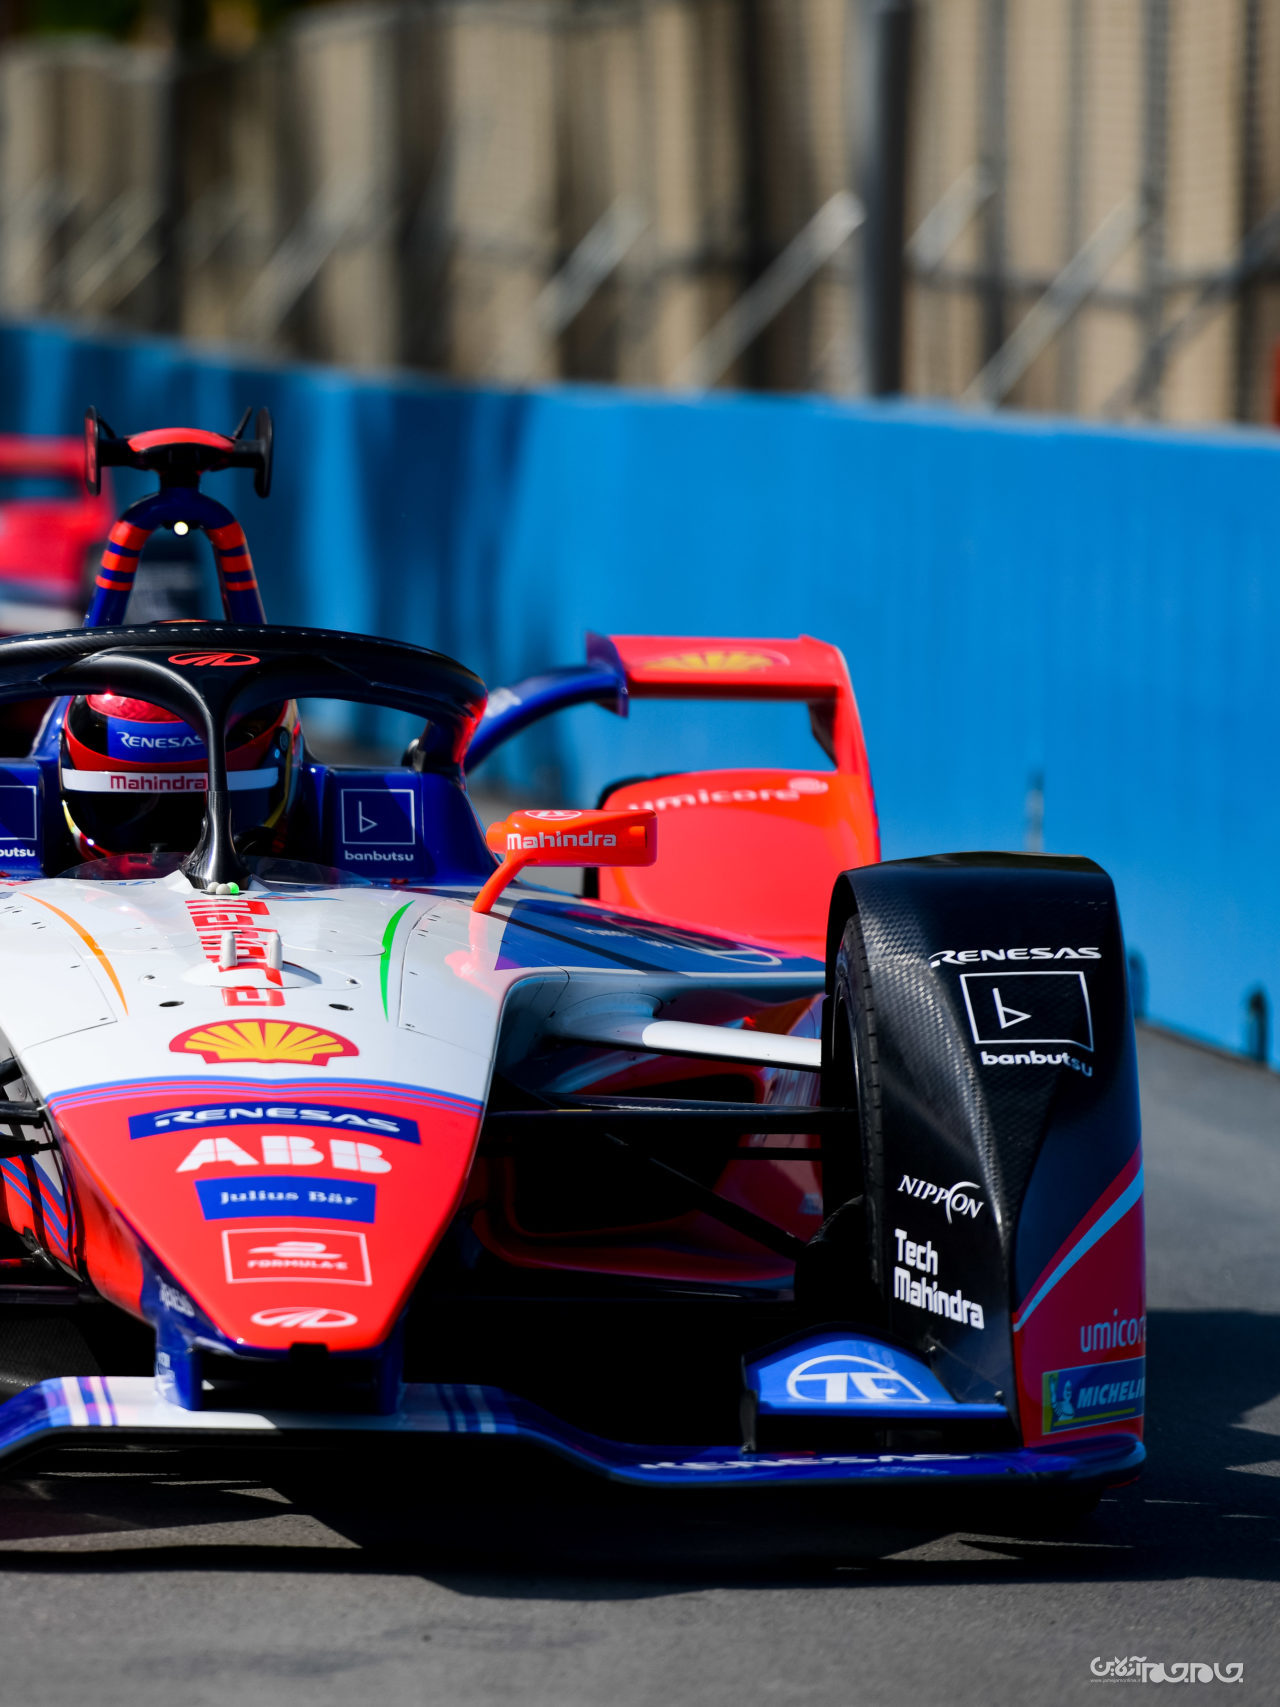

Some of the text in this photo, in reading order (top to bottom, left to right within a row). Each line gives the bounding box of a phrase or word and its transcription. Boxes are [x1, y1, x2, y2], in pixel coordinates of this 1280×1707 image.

[110, 775, 207, 791] Mahindra
[628, 789, 800, 811] umicore
[507, 831, 617, 850] Mahindra
[344, 850, 414, 862] banbutsu
[928, 947, 1102, 968] RENESAS
[980, 1051, 1093, 1077] banbutsu
[154, 1107, 401, 1132] RENESAS
[176, 1135, 392, 1173] ABB
[220, 1190, 359, 1205] Julius Bär
[897, 1174, 984, 1220] NIPPON
[894, 1228, 938, 1276] Tech
[894, 1266, 985, 1330] Mahindra
[1080, 1308, 1146, 1352] umicor
